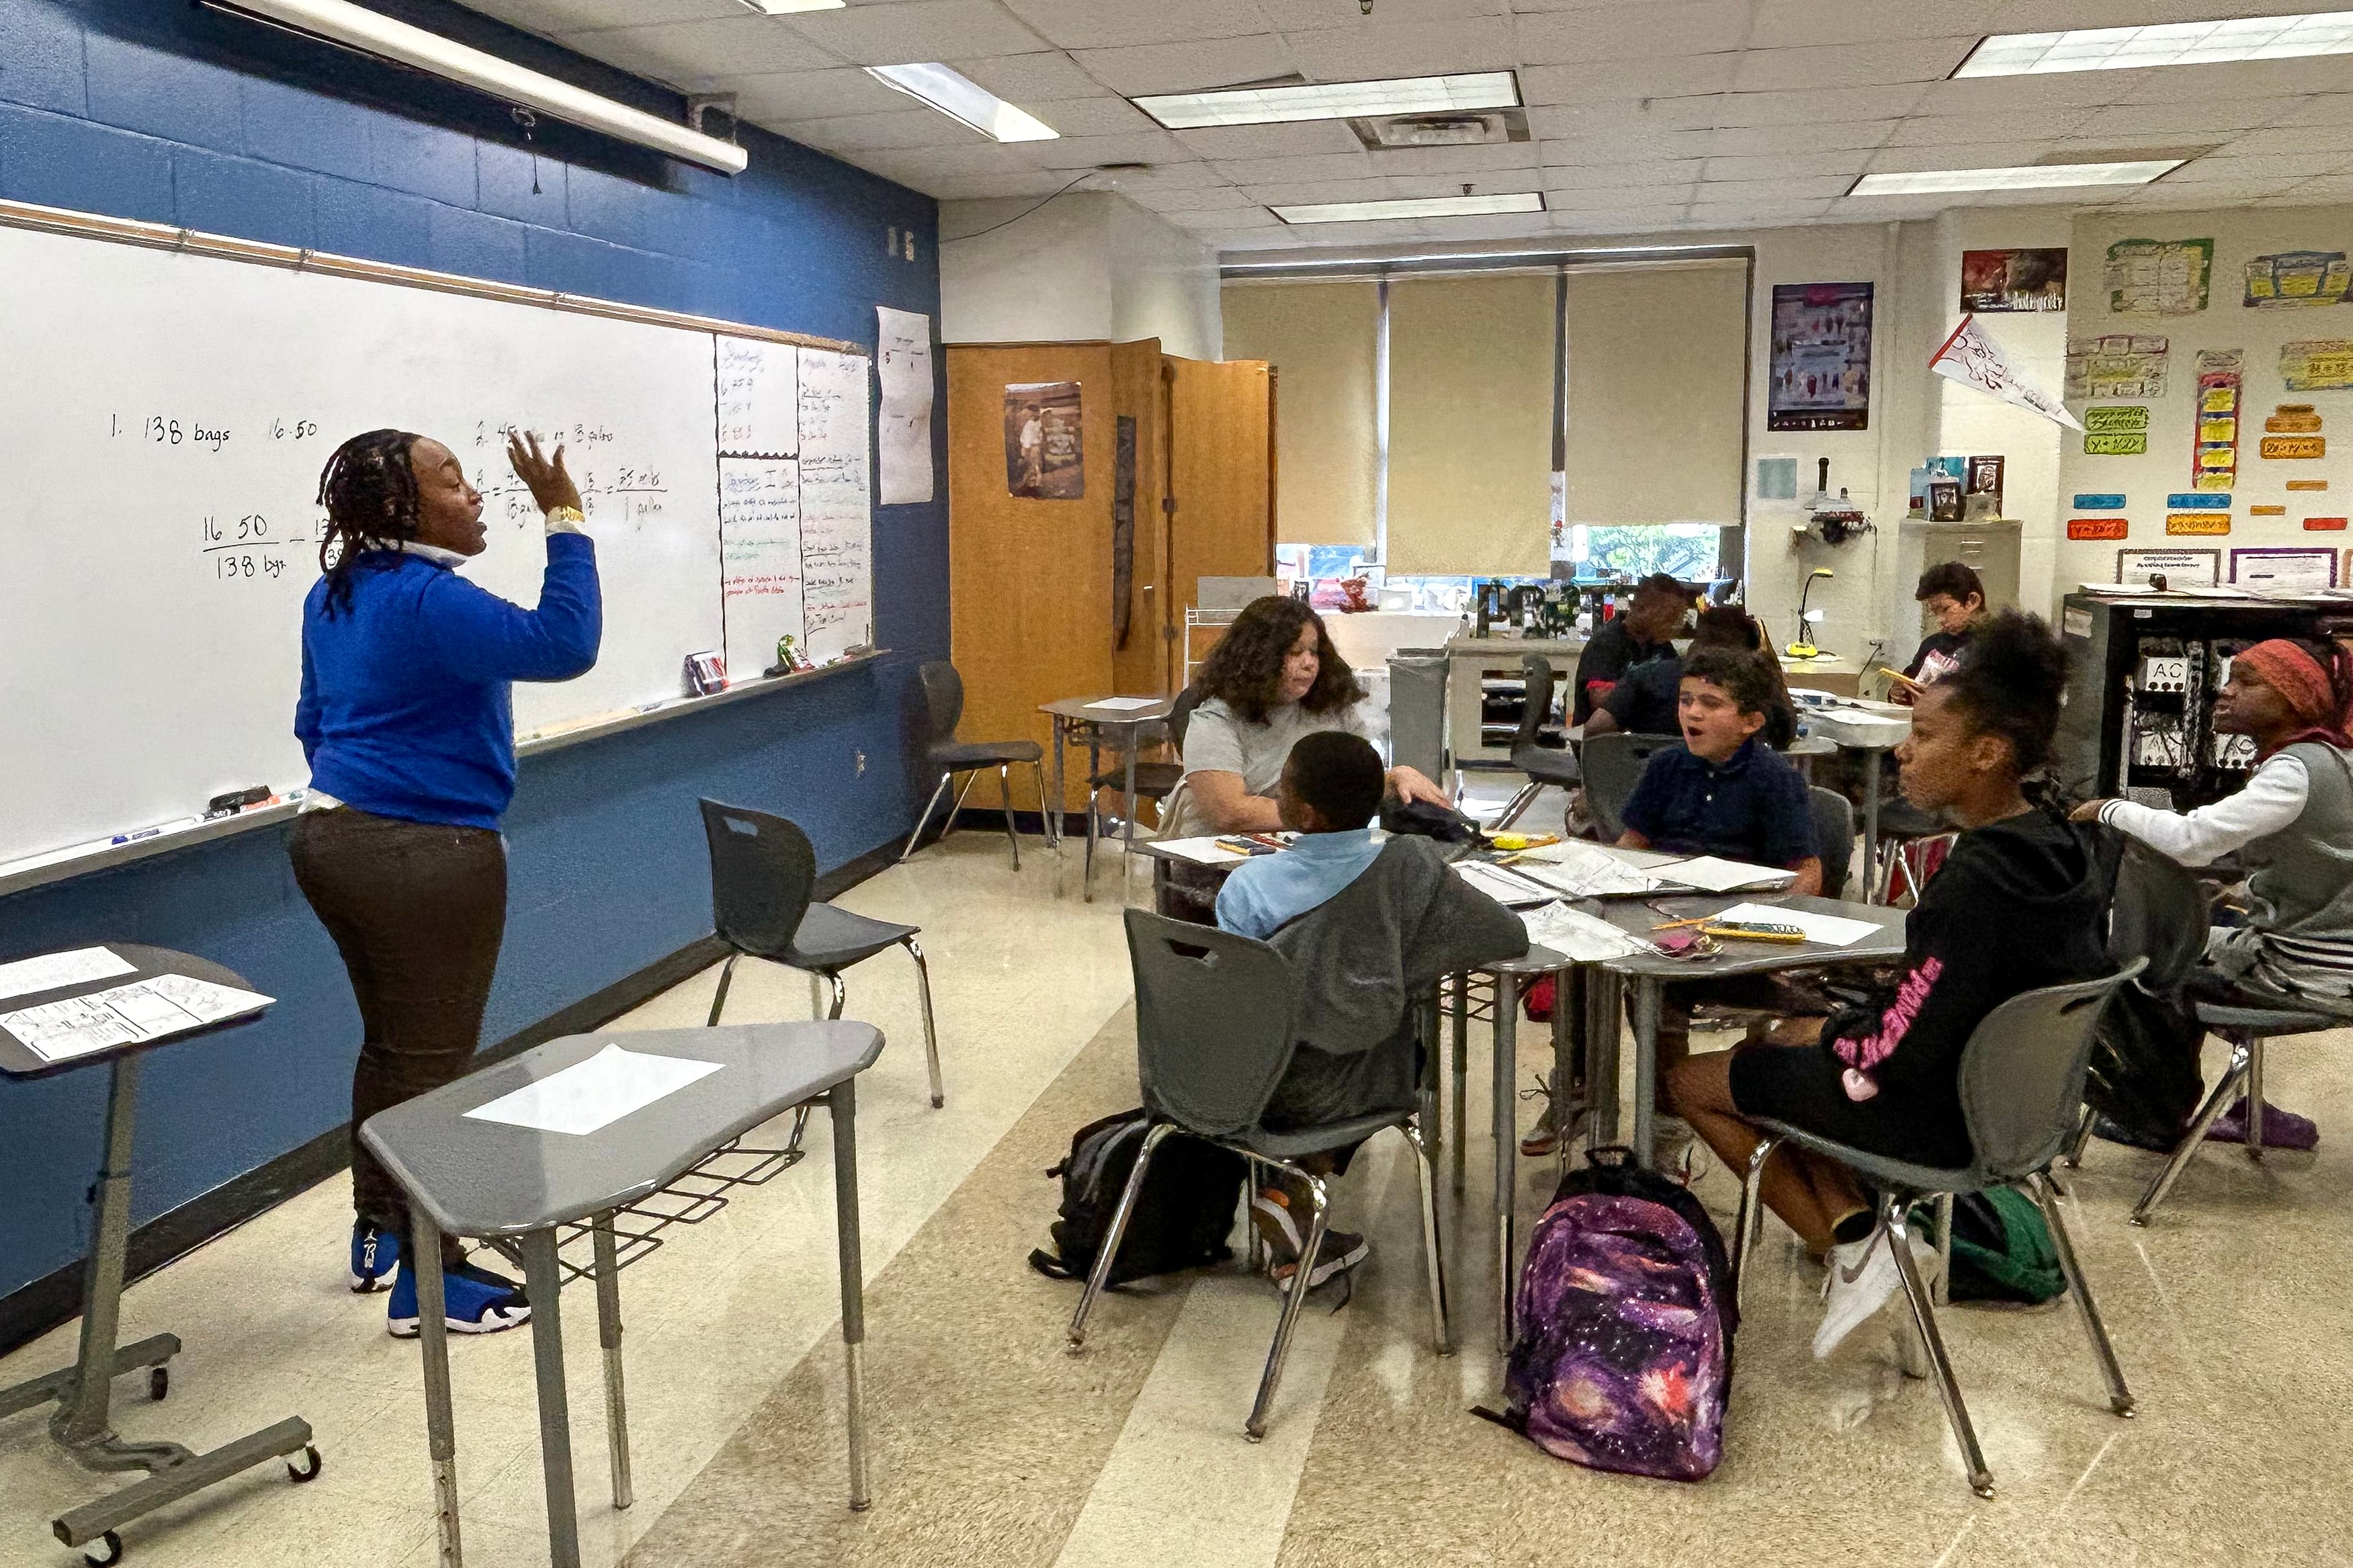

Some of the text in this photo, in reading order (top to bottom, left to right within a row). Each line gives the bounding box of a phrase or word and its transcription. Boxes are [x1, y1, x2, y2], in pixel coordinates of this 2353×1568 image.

[144, 415, 183, 445] 138
[194, 423, 230, 453] bags
[217, 556, 255, 579] 138
[2153, 662, 2183, 679] AC
